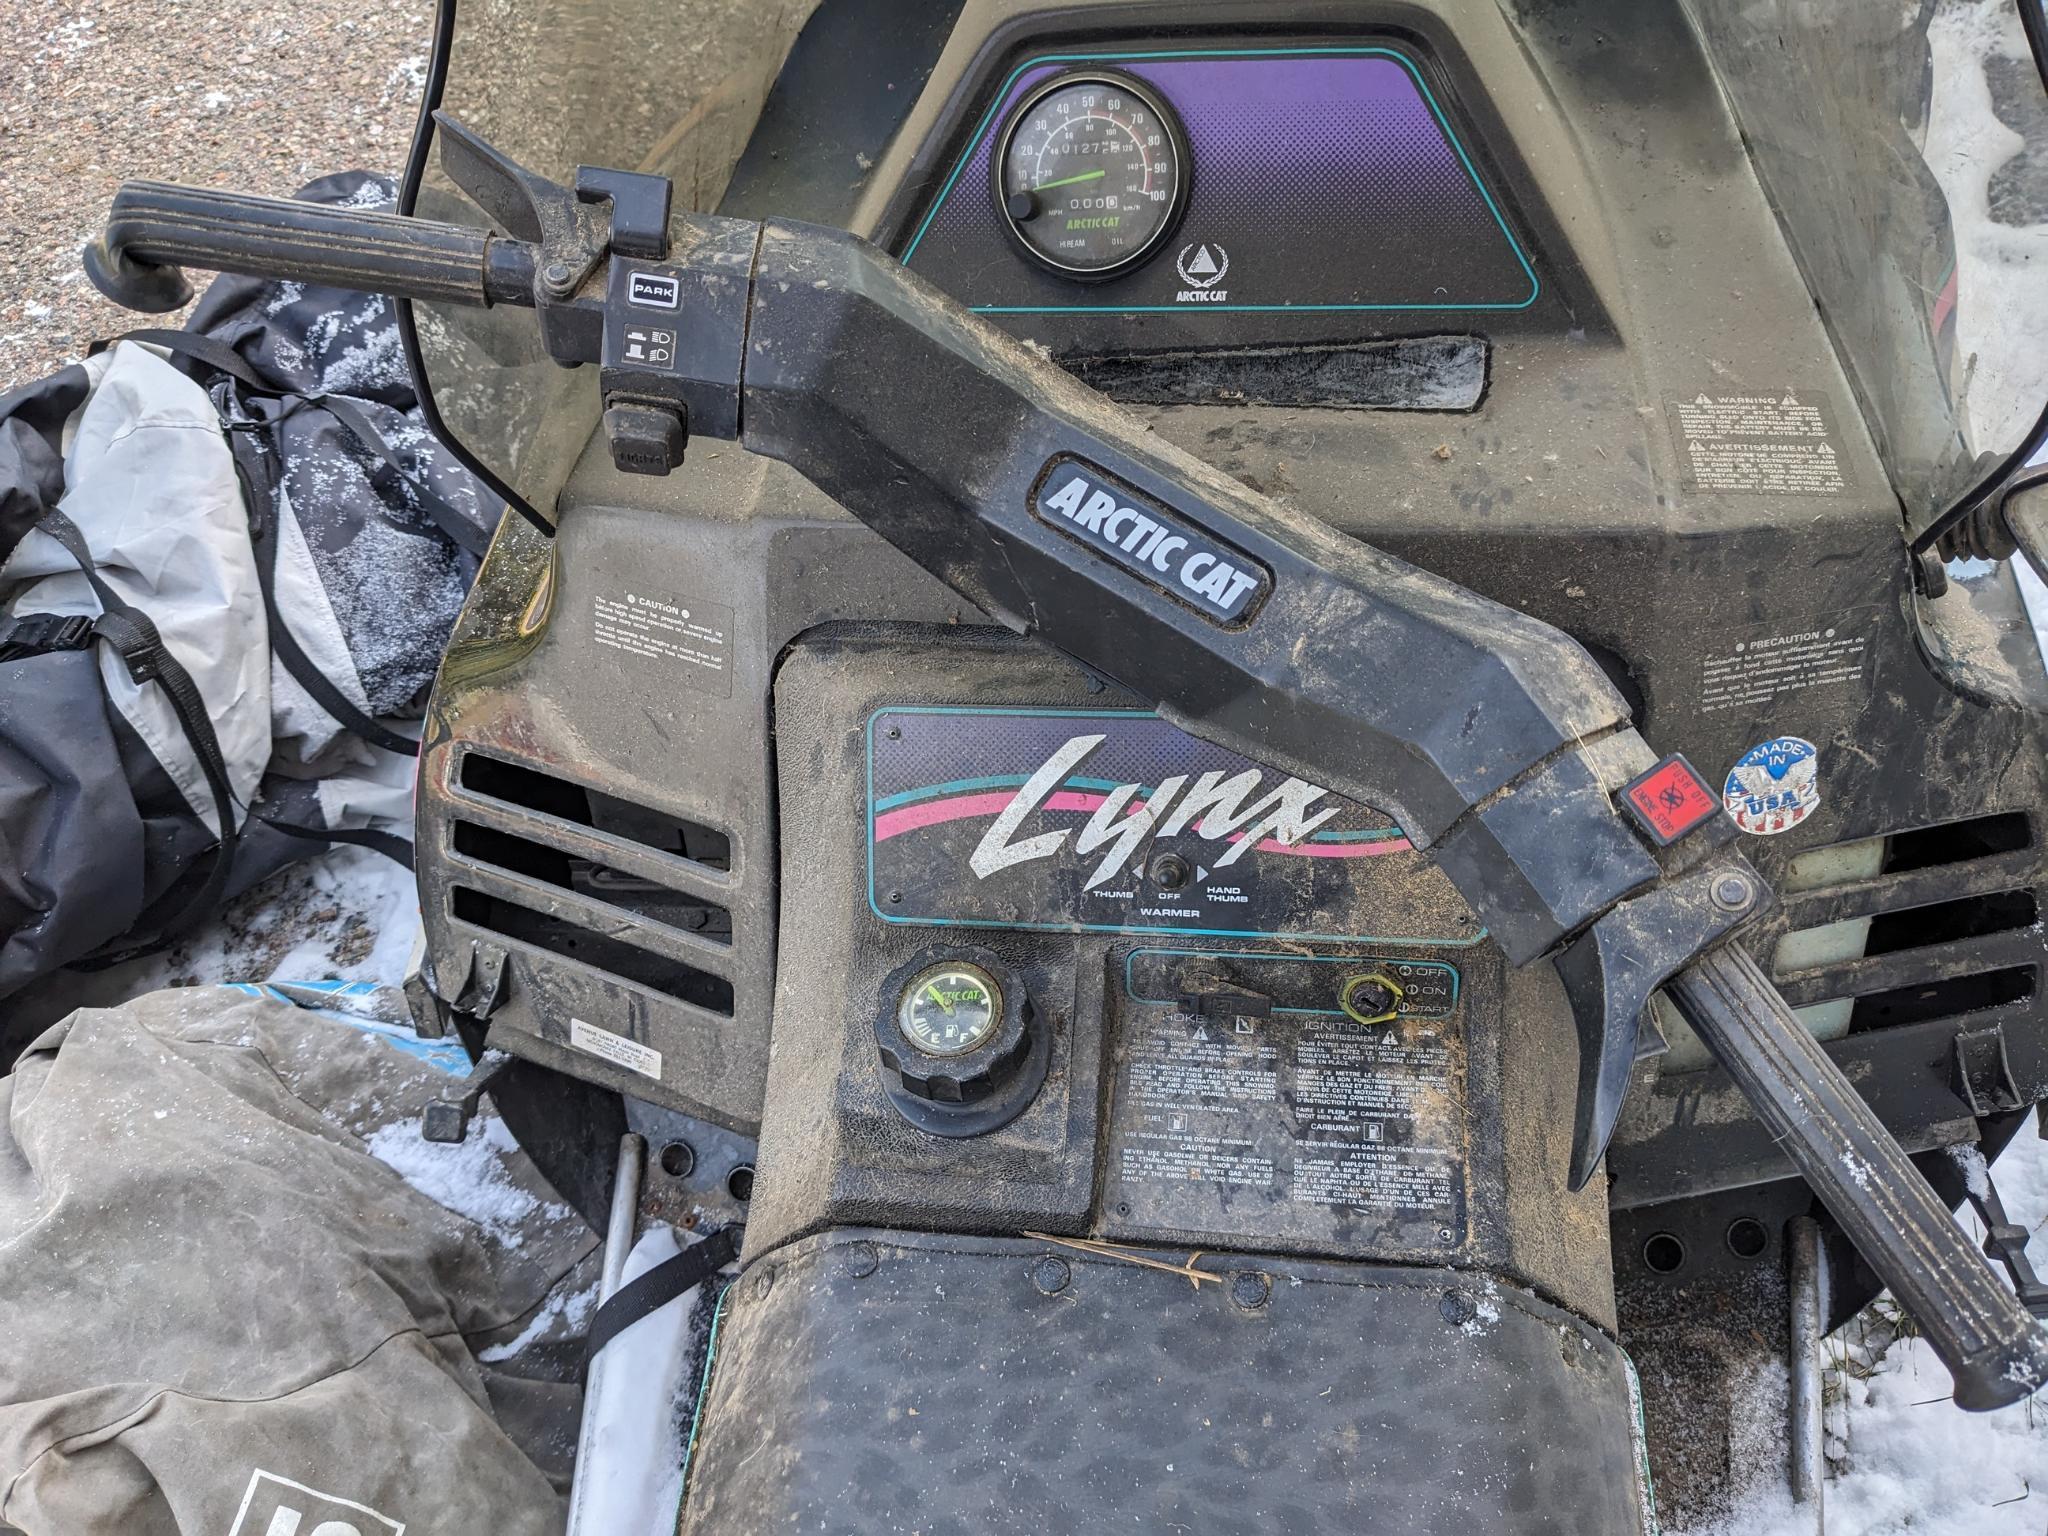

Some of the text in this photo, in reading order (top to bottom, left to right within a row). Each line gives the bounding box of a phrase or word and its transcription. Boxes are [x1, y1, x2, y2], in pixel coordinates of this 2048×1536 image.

[1082, 96, 1094, 107] 50
[1108, 99, 1120, 110] 60
[1056, 104, 1069, 114] 40
[1131, 113, 1143, 124] 70
[1035, 120, 1046, 130] 30
[1148, 135, 1160, 146] 80
[1021, 144, 1033, 155] 20
[1154, 162, 1166, 173] 90
[1018, 170, 1027, 180] 10
[1150, 191, 1165, 201] 100
[1066, 216, 1120, 230] ARCTIC CAT
[635, 284, 673, 297] PARK
[1176, 291, 1228, 302] ARCTIC CAT
[1708, 443, 1814, 452] AVERTISSEMENT
[1045, 477, 1259, 610] ARCTIC CAT
[638, 597, 679, 616] CAUTION
[1750, 630, 1820, 650] PRECAUTION
[1752, 740, 1804, 762] MADE
[1769, 756, 1786, 766] IN
[1670, 764, 1711, 808] PUSH OFF
[1748, 791, 1798, 816] USA
[968, 734, 1341, 893] Lynx
[1634, 789, 1674, 832] ENGINE STOP
[1093, 890, 1134, 899] THUMB
[1206, 894, 1249, 903] THUMB
[1140, 908, 1200, 917] WARMER
[1416, 968, 1448, 977] OFF
[962, 990, 980, 999] CAT
[1422, 987, 1446, 996] ON
[1305, 1021, 1372, 1033] IGNITION
[931, 1033, 940, 1044] E
[960, 1032, 969, 1043] F
[1314, 1033, 1378, 1042] AVERTISSEMENT
[1310, 1123, 1361, 1131] CARBURANT
[1179, 1143, 1217, 1152] CAUTION
[1350, 1152, 1397, 1161] ATTENTION
